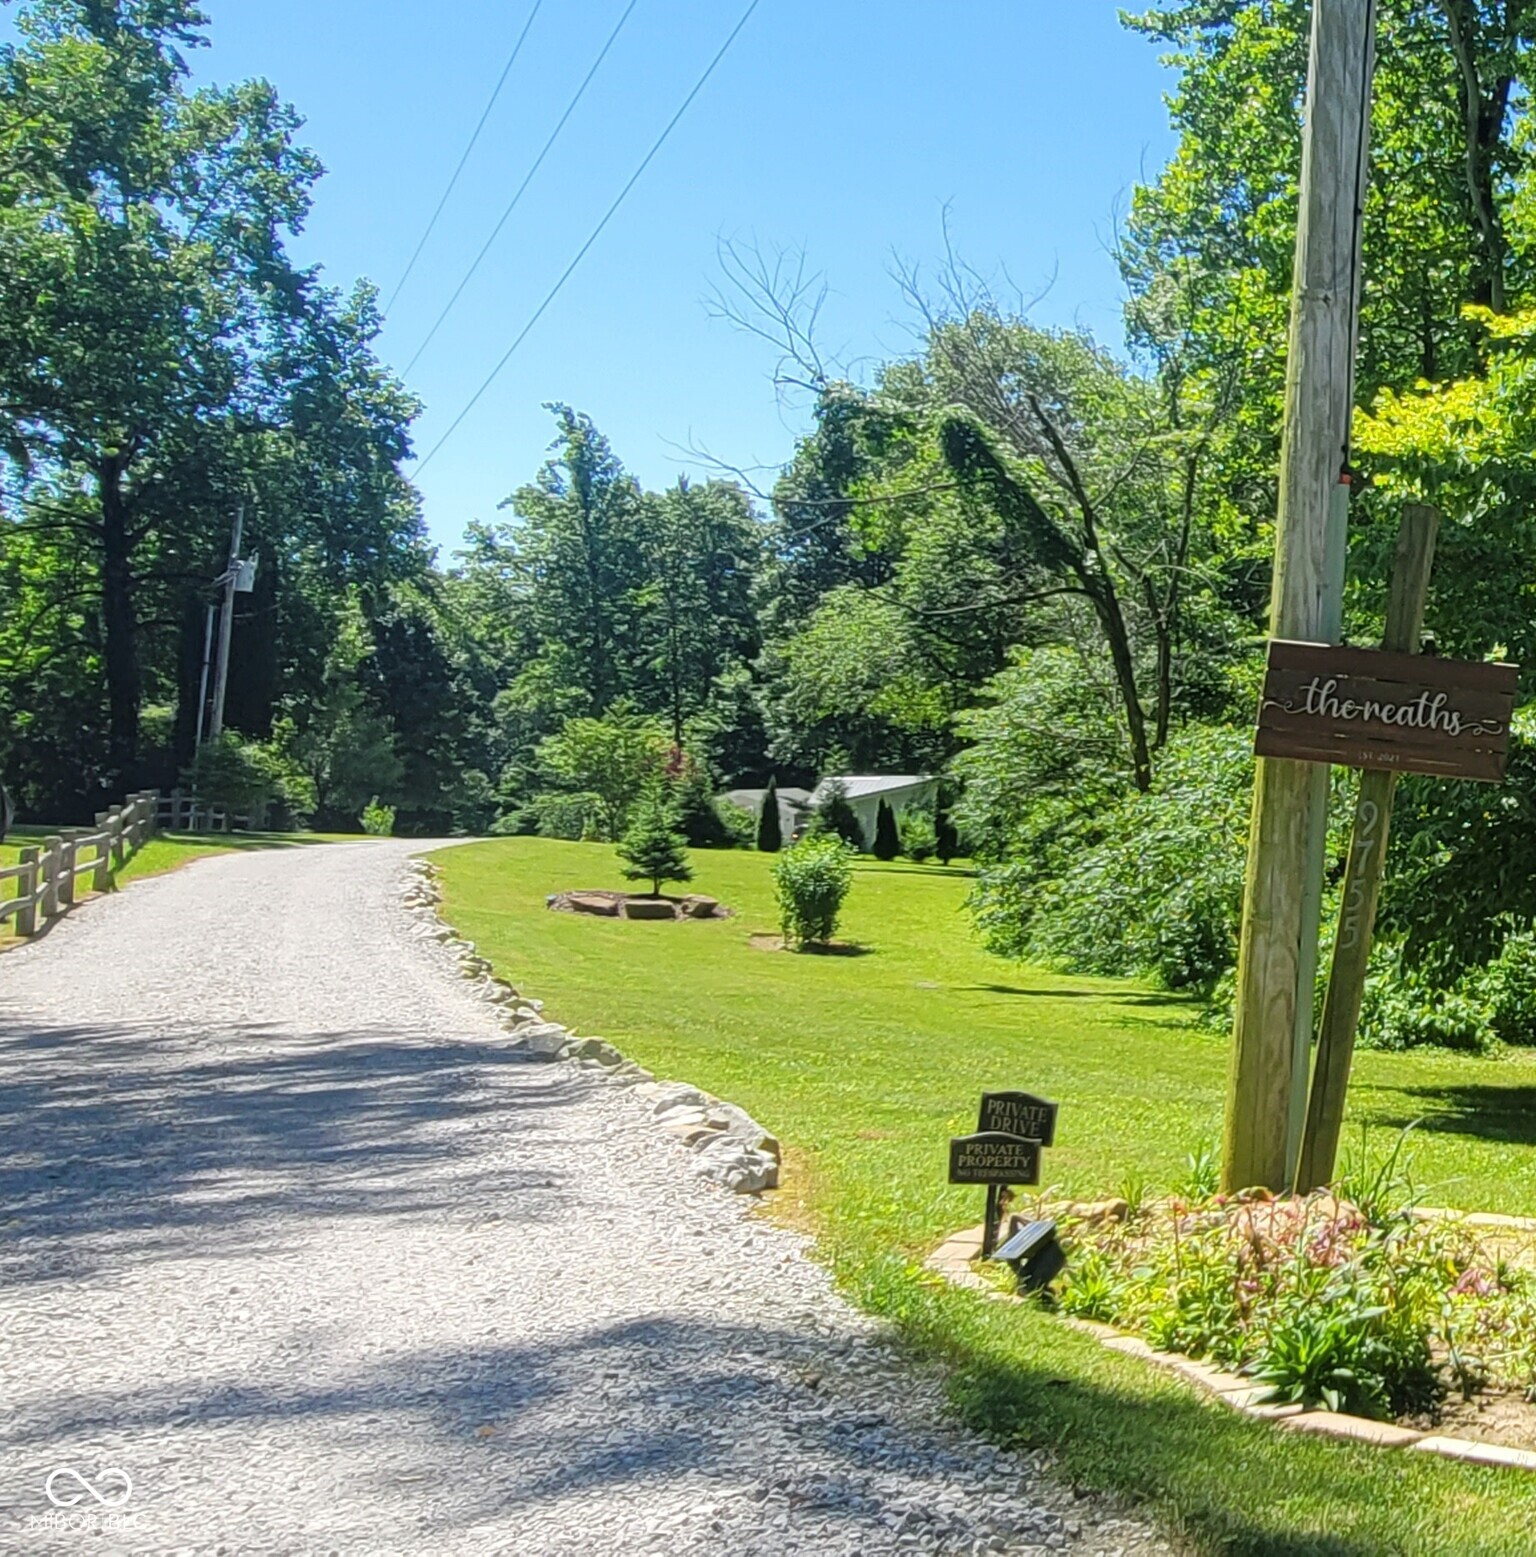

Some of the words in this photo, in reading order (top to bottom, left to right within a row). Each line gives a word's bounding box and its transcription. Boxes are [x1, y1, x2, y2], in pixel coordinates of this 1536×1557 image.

[1298, 677, 1360, 719] the
[1363, 692, 1462, 737] reaths
[1341, 801, 1378, 948] 9755
[987, 1099, 1047, 1123] PRIVATE
[990, 1115, 1040, 1137] DRIVE
[966, 1143, 1024, 1155] PRIVATE
[958, 1155, 1031, 1168] PROPERTY
